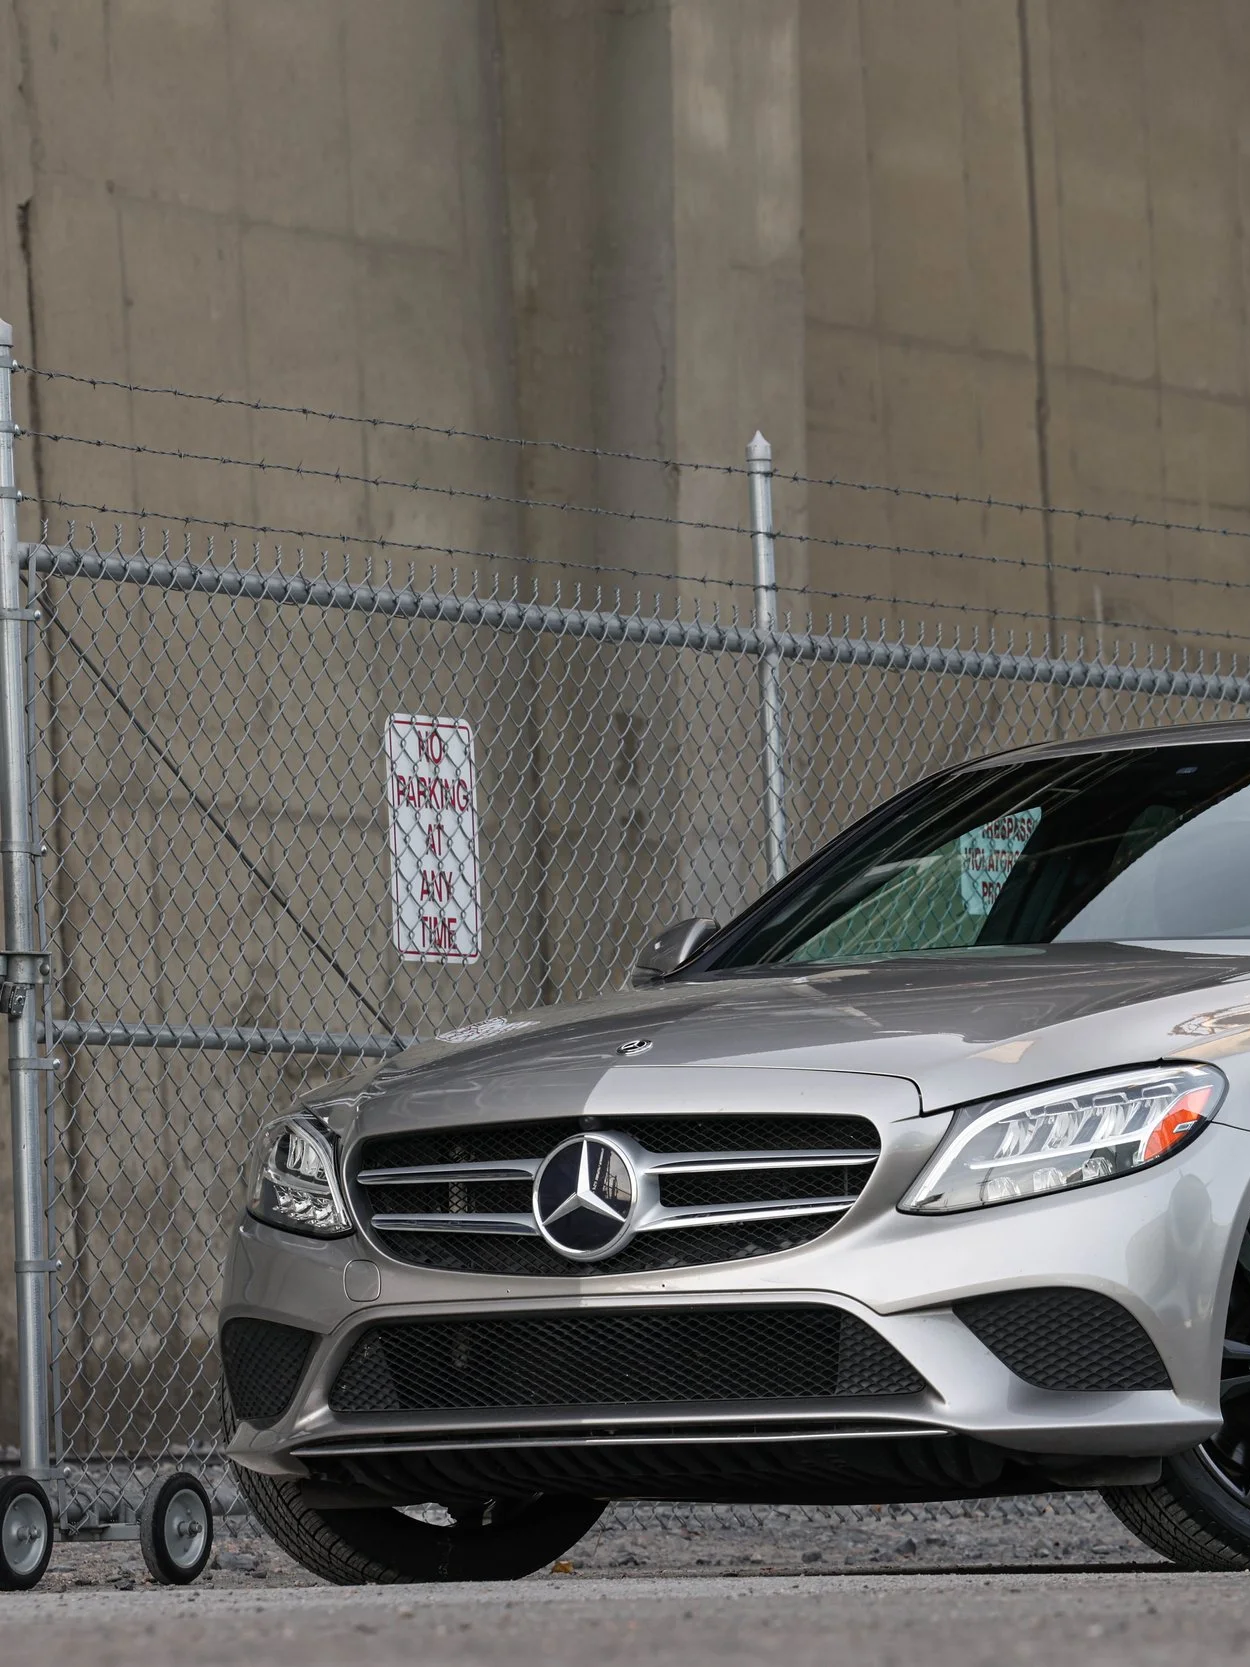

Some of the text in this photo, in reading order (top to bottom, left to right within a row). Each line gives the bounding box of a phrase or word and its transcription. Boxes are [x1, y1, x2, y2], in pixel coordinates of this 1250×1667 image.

[418, 730, 443, 764] NO
[397, 775, 469, 812] PARKING
[426, 824, 444, 856] AT
[420, 870, 453, 903] ANY
[421, 916, 458, 948] TIME
